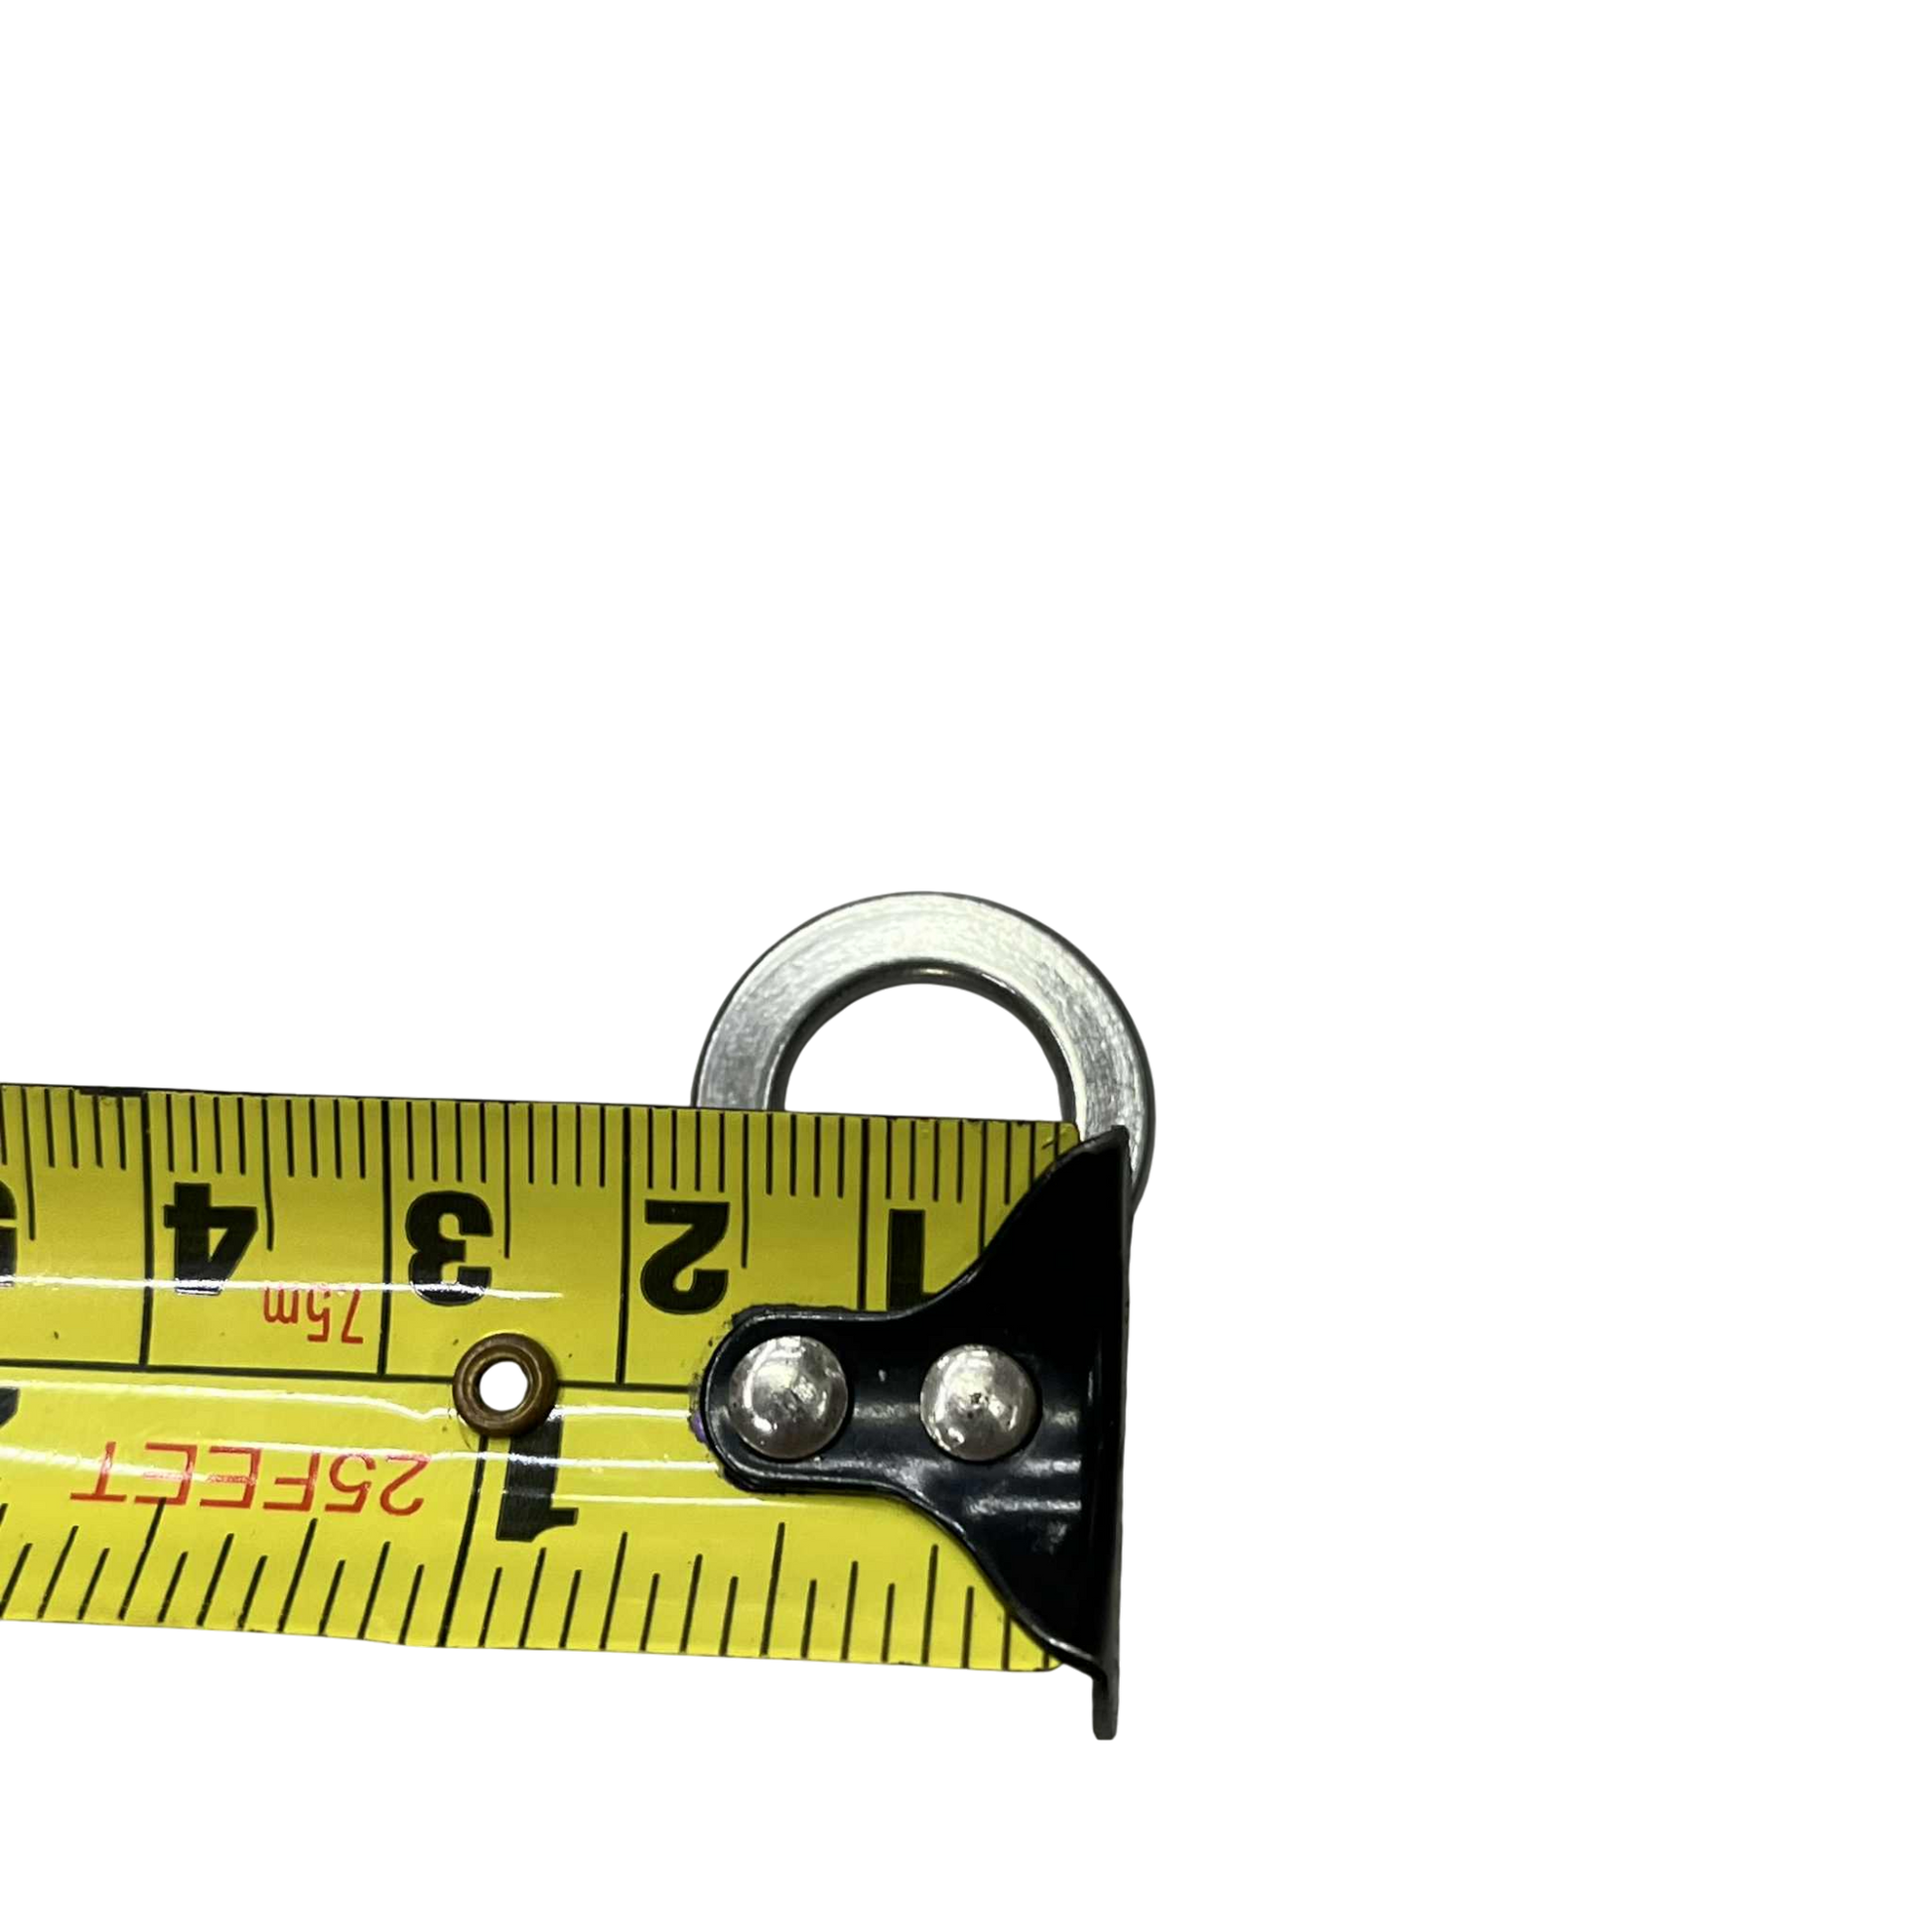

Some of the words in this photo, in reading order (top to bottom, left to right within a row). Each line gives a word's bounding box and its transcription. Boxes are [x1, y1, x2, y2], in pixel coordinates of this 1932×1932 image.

[164, 1182, 258, 1295] 4
[405, 1190, 493, 1306] 3
[640, 1199, 730, 1314] 2
[887, 1208, 940, 1311] 1
[263, 1285, 363, 1344] 75m
[69, 1442, 431, 1516] 25FEET
[494, 1418, 579, 1544] 1
